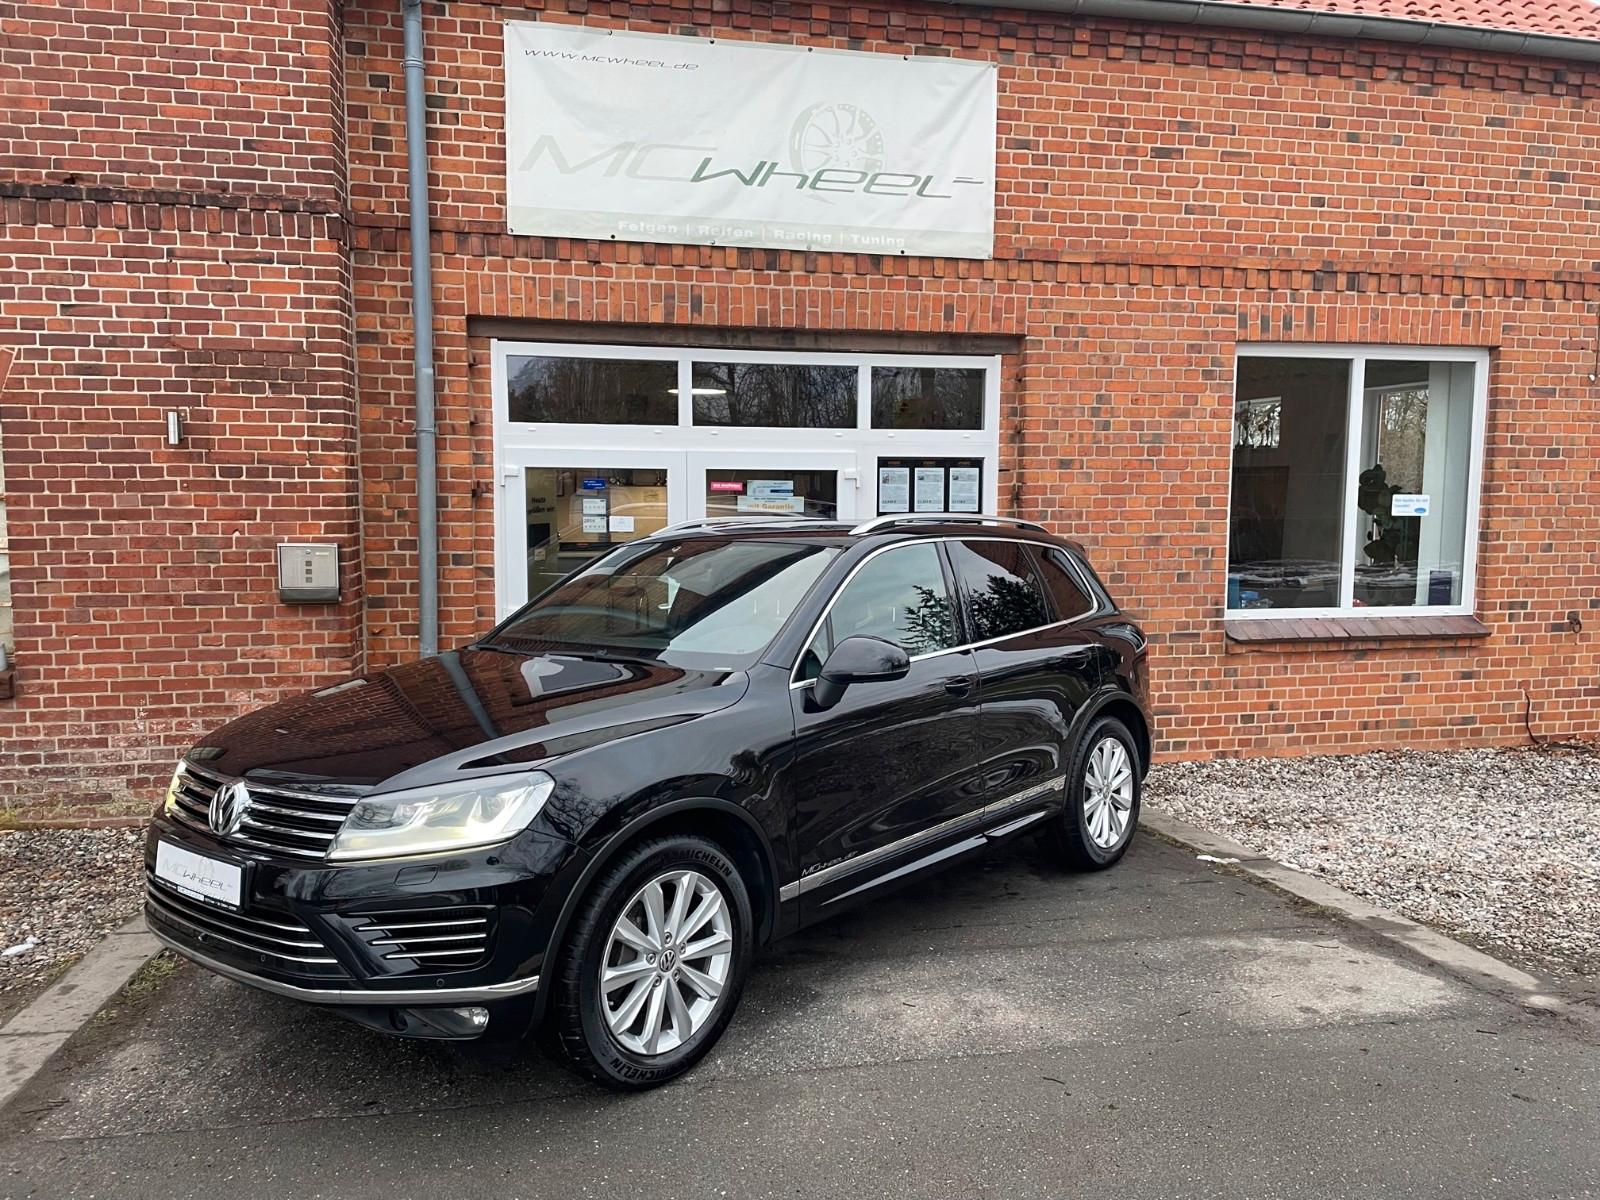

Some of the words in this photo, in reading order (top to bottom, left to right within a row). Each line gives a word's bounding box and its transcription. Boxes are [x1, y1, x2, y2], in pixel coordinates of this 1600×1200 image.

[618, 220, 678, 235] Felgen
[699, 224, 753, 238] Reifen
[773, 229, 832, 244] Racing
[850, 233, 906, 248] Tuning
[761, 502, 795, 510] Garantie
